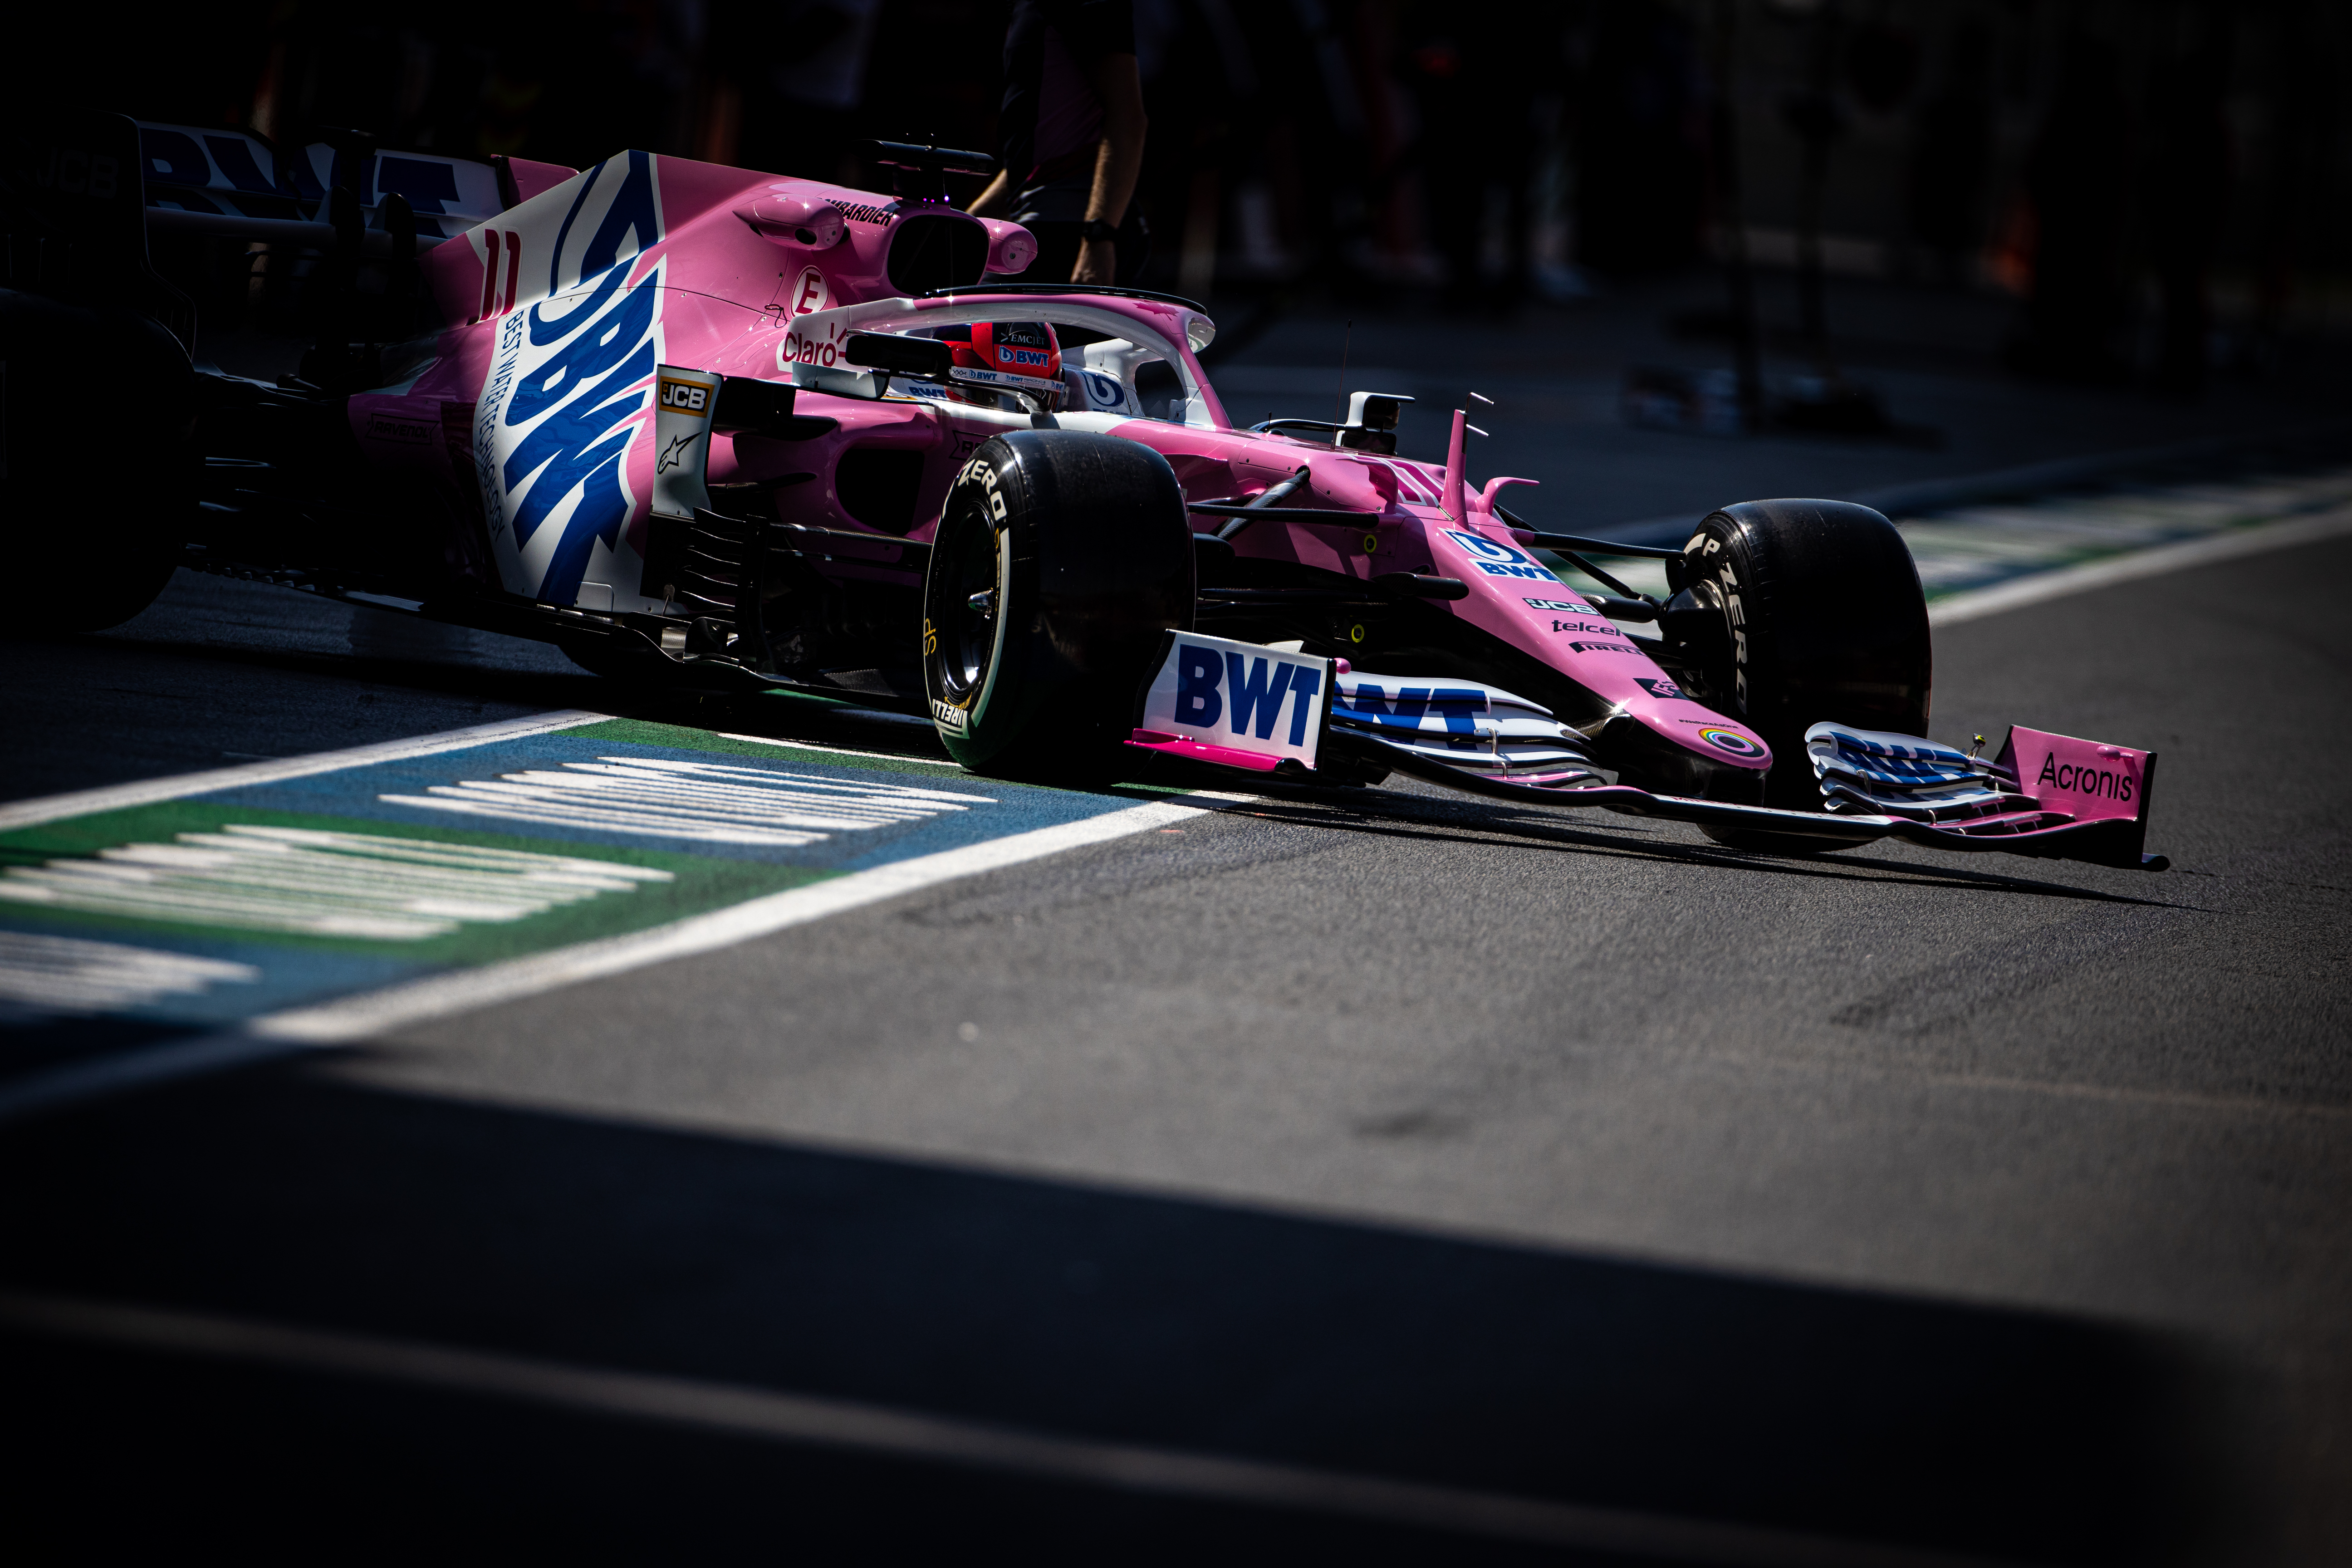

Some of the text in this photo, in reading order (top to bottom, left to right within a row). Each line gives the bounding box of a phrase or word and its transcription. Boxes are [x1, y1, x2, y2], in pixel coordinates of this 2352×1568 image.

[36, 147, 118, 199] JCB
[480, 229, 520, 320] 11
[795, 273, 820, 314] E
[783, 332, 836, 367] Claro
[1010, 334, 1044, 345] EMCJET
[1016, 350, 1049, 367] BWT
[977, 372, 997, 381] BWT
[662, 384, 706, 409] JCB
[908, 387, 947, 398] BWT
[374, 421, 428, 439] RAVENOL
[479, 310, 524, 542] BEST WATER TECHNOLOGY
[504, 267, 658, 606] BWT
[958, 459, 1007, 522] ZERO
[1475, 562, 1558, 581] BWT
[1531, 599, 1598, 615] JCB
[1552, 620, 1620, 637] telcel
[1719, 562, 1748, 715] ZERO
[1174, 644, 1321, 747] BWT
[1679, 719, 1739, 729] #WeRaceAsOne
[2038, 752, 2133, 802] Acronis
